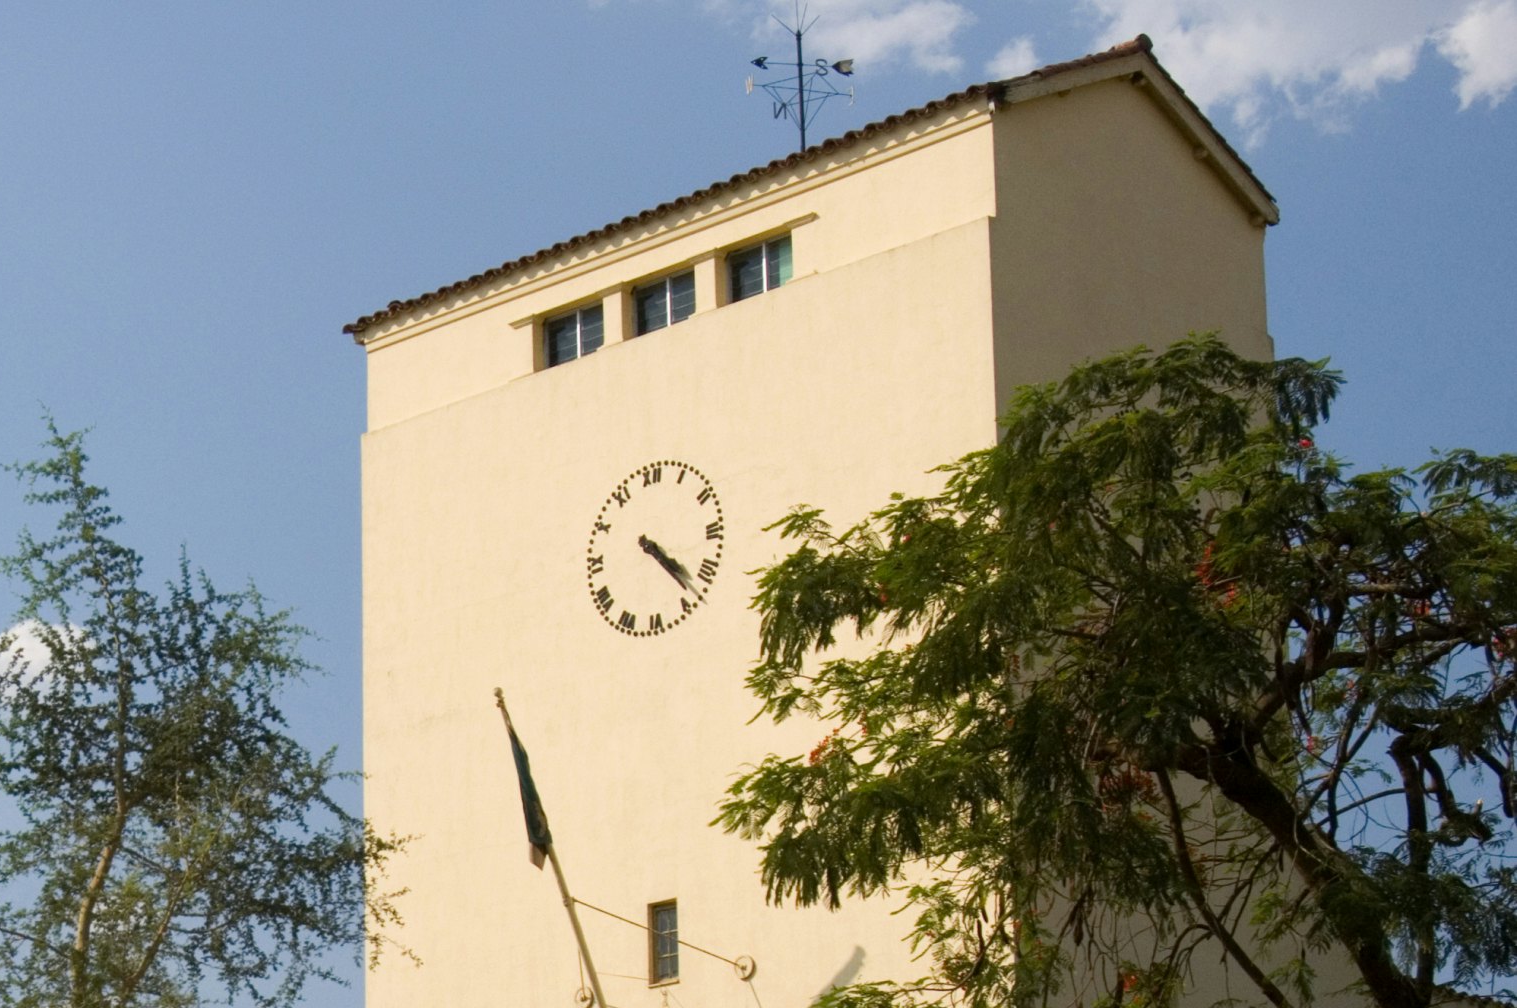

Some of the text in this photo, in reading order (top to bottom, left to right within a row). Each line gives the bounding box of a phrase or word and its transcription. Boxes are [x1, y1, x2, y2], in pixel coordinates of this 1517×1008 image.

[642, 466, 662, 488] XII
[613, 486, 631, 508] XI
[696, 487, 711, 506] II
[597, 521, 612, 535] X
[705, 520, 720, 541] III
[589, 554, 604, 575] IX
[596, 584, 614, 613] VIII
[618, 610, 636, 631] VII
[649, 613, 663, 631] VI
